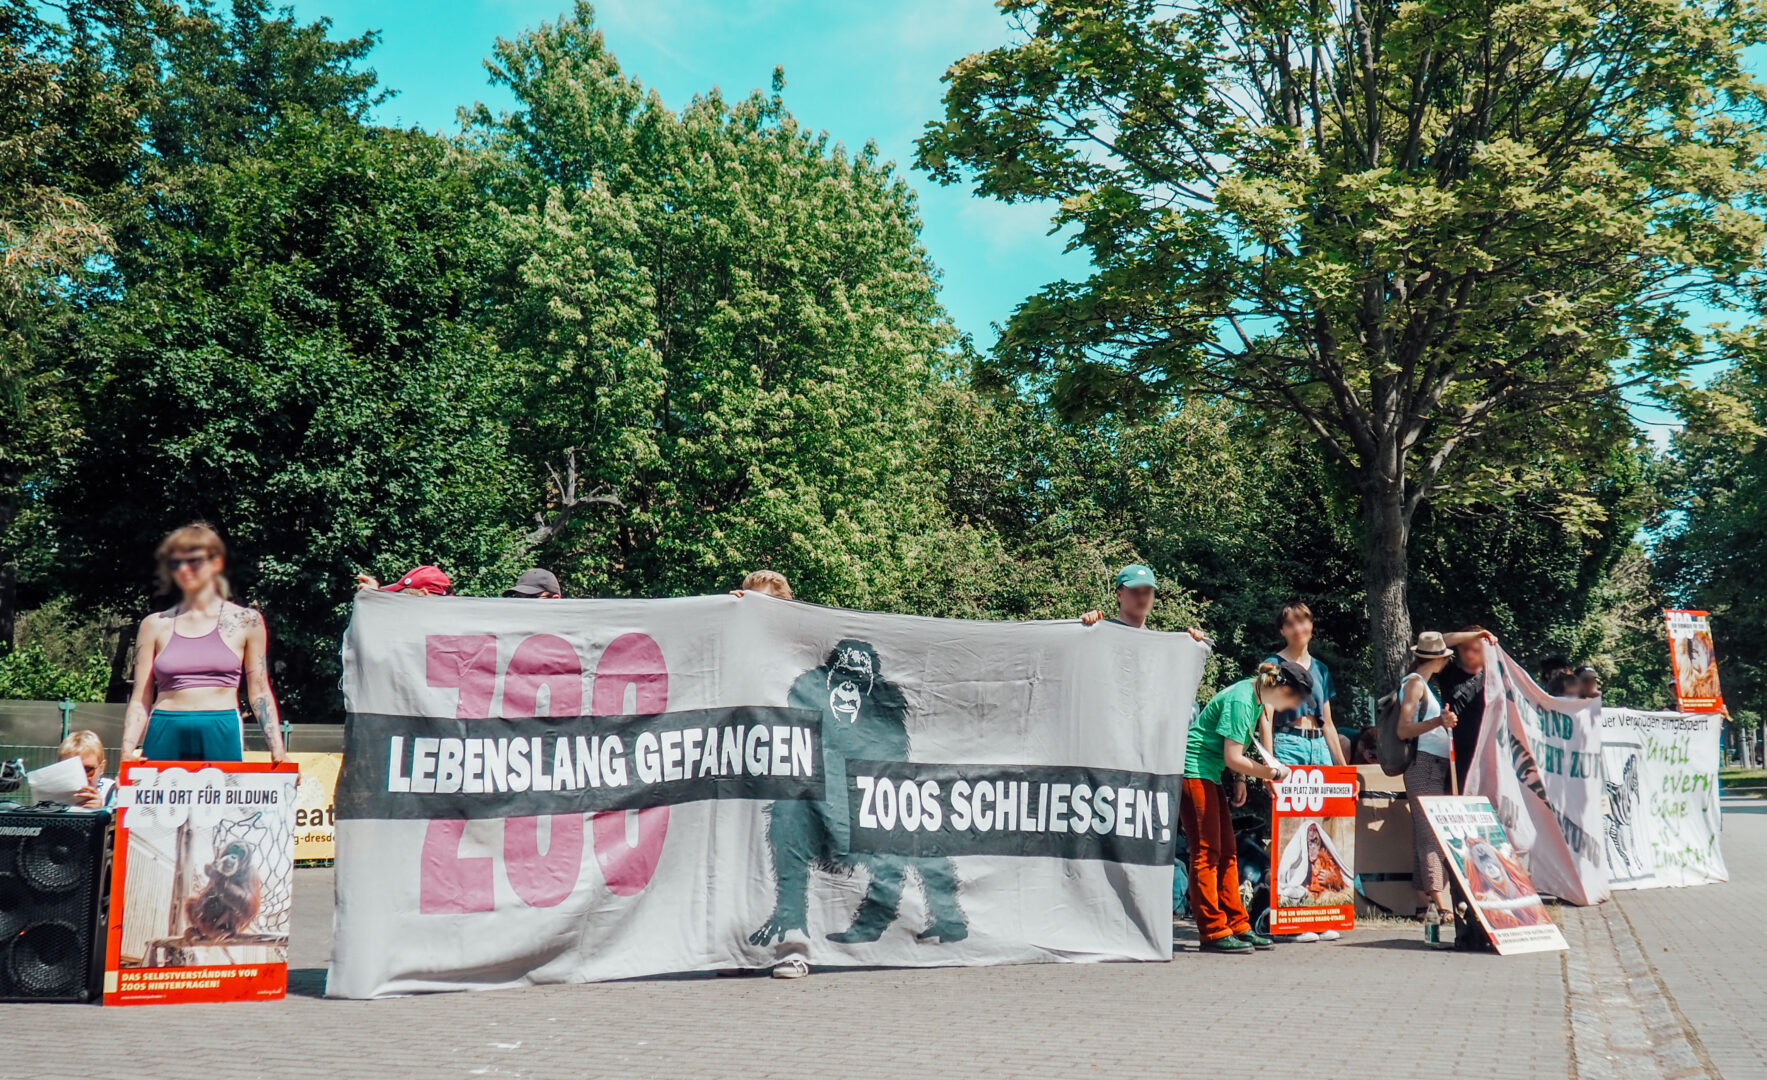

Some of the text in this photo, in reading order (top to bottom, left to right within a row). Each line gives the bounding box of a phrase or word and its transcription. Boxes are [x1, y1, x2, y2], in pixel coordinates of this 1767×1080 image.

[1536, 704, 1573, 740] SIND
[1661, 717, 1708, 734] eingesperrt
[388, 724, 813, 793] LEBENSLANG GEFANGEN
[420, 633, 669, 914] ZOO
[1526, 736, 1564, 775] ICHT
[124, 767, 226, 828] ZOO
[135, 785, 278, 805] KEIN ORT FÜR BILDUNG
[856, 775, 1170, 842] ZOOS SCHLIESSEN!
[1276, 768, 1324, 811] ZOO
[1281, 786, 1350, 794] KEIN PLATZ ZUM AUFWACHSEN
[1662, 769, 1714, 812] every
[120, 980, 220, 991] ZOOS HINTERFRAGEN!
[121, 969, 258, 981] DAS SELBSTVERSTÄNDNIS VON
